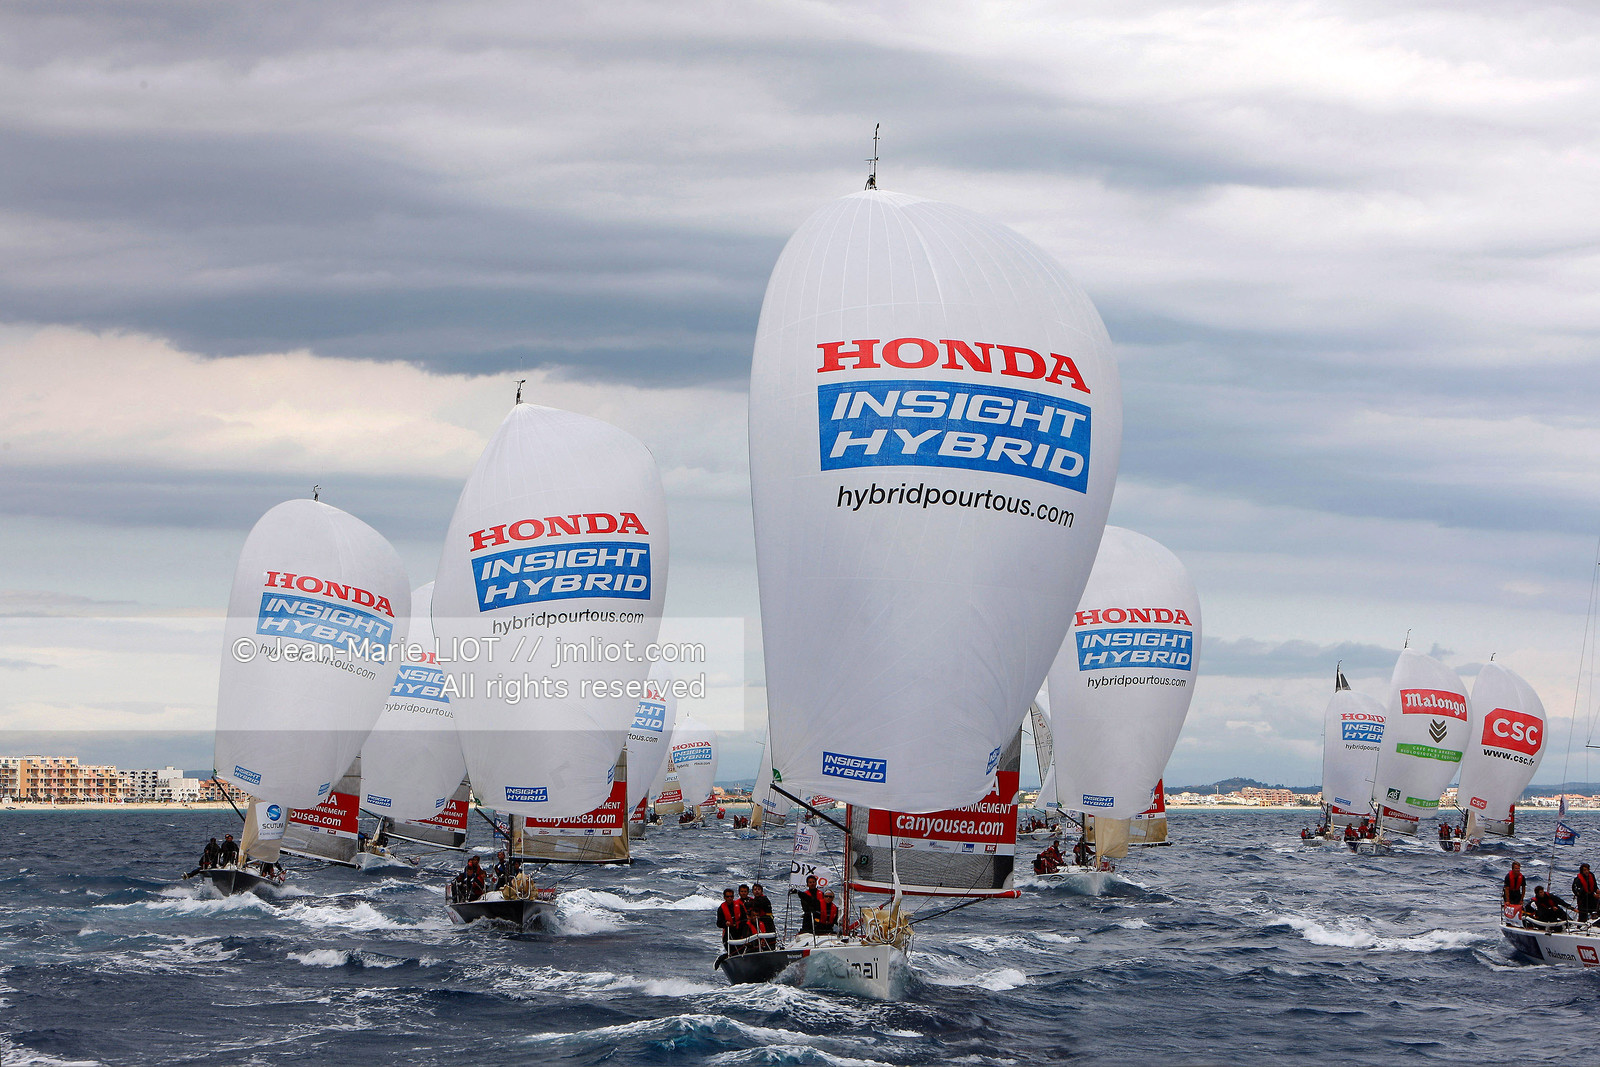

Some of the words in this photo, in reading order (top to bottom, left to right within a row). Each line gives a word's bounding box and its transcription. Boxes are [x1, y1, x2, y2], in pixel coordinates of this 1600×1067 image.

[817, 337, 1091, 394] HONDA
[831, 390, 1087, 438] INSIGHT
[829, 429, 1085, 478] HYBRID
[837, 482, 1075, 528] hybridpourtous.com
[468, 512, 649, 552] HONDA
[481, 548, 647, 581] INSIGHT
[264, 571, 395, 618] HONDA
[484, 573, 648, 604] HYBRID
[264, 598, 391, 639] INSIGHT
[492, 608, 644, 635] hybridpourtous.com
[1074, 608, 1192, 627] HONDA
[260, 617, 384, 661] HYBR
[1082, 632, 1191, 649] INSIGHT
[1083, 650, 1190, 665] HYBRID
[1087, 675, 1187, 689] hybridpourtous.com
[1405, 692, 1466, 716] Malongo
[1492, 718, 1538, 746] CSC
[672, 741, 711, 751] HONDA
[1483, 749, 1535, 766] www.csc.fr
[824, 755, 885, 770] INSIGHT
[824, 765, 884, 780] HYBRID
[896, 815, 1004, 837] canyousea.com
